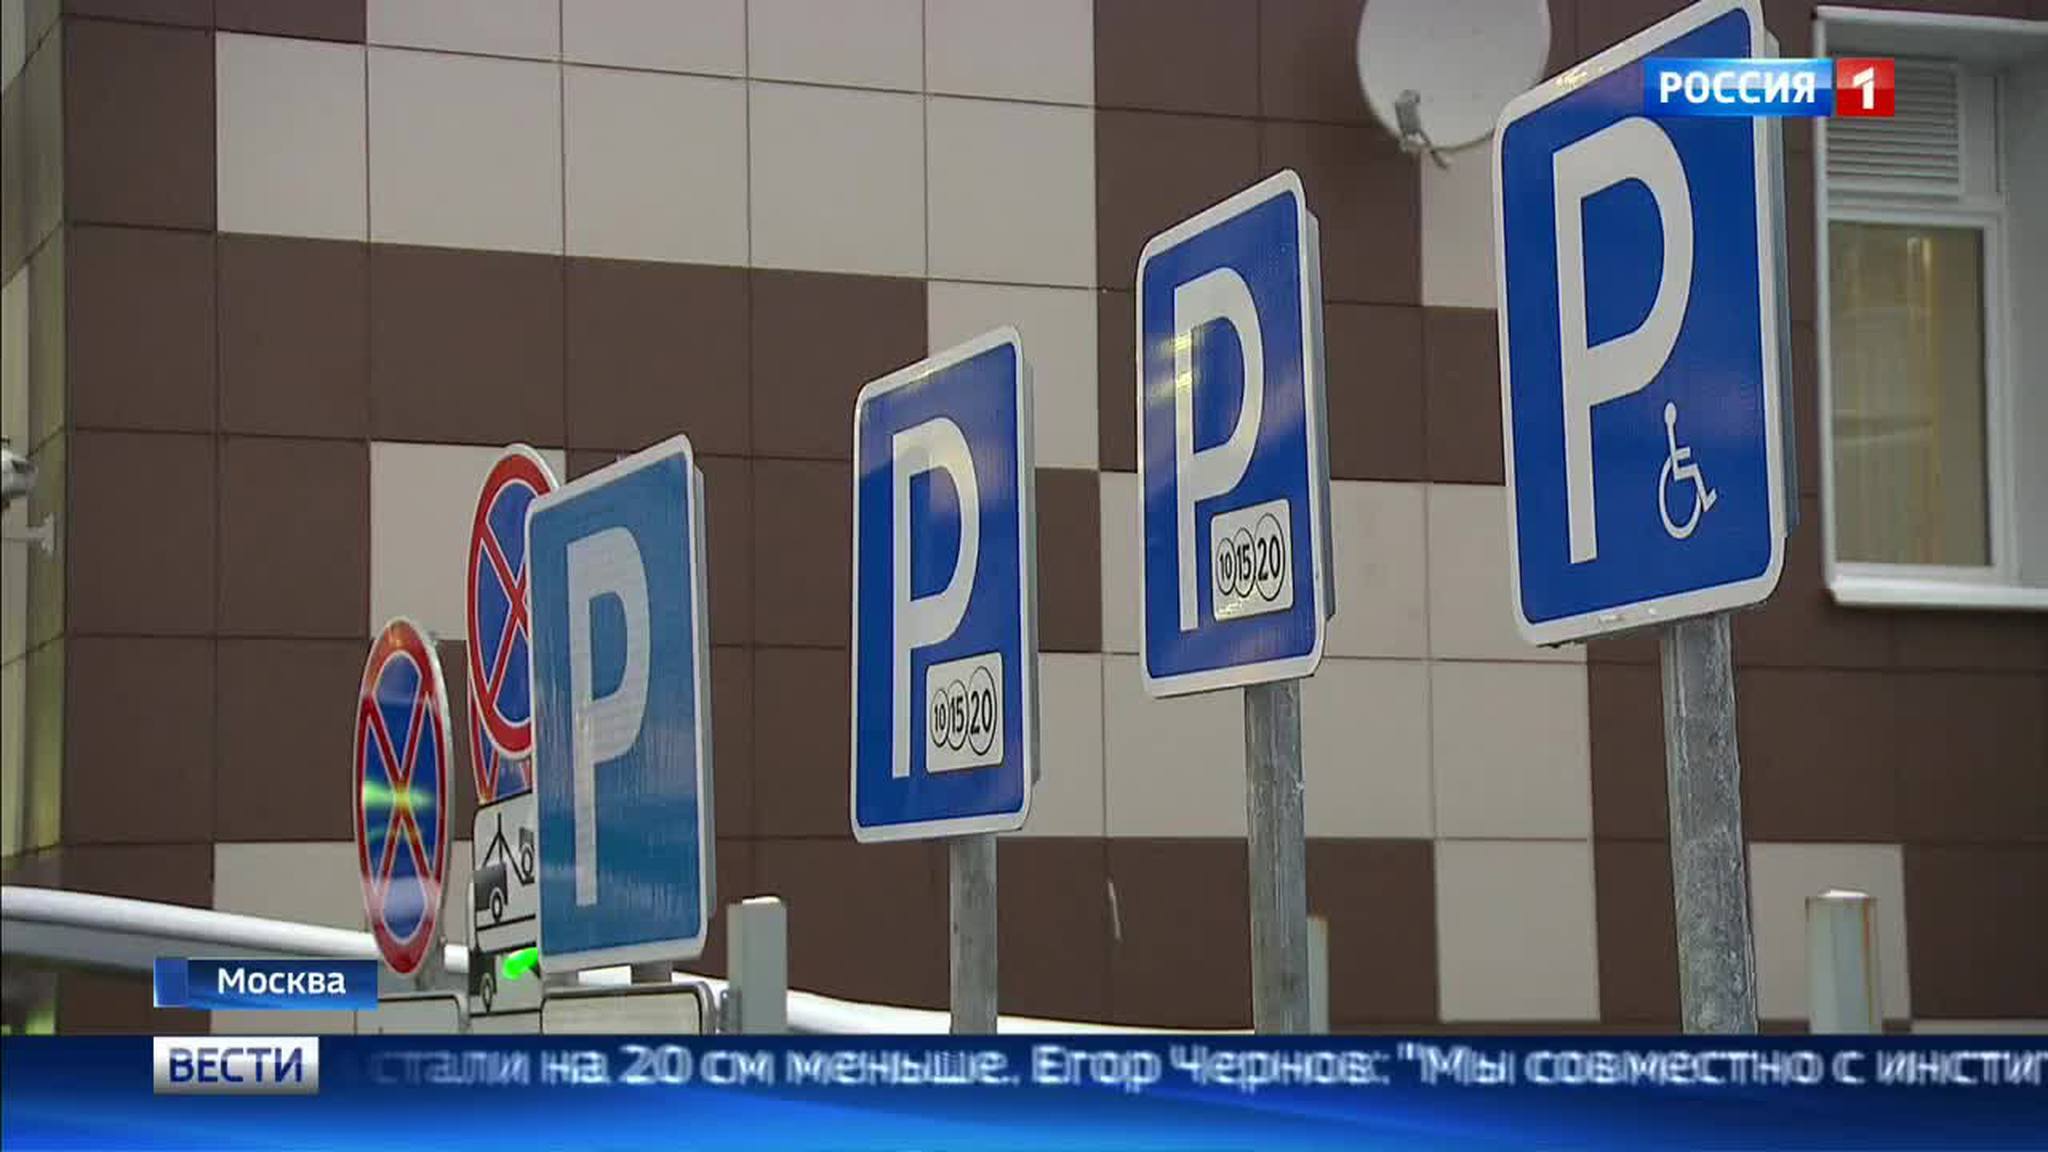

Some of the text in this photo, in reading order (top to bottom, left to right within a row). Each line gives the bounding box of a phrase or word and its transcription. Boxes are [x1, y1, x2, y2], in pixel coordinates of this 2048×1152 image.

[1174, 266, 1264, 632] P
[1552, 116, 1694, 564] P
[567, 526, 650, 908] P
[893, 417, 980, 779] P
[934, 688, 993, 735] 10 15 20
[1219, 534, 1281, 582] 10 15 20
